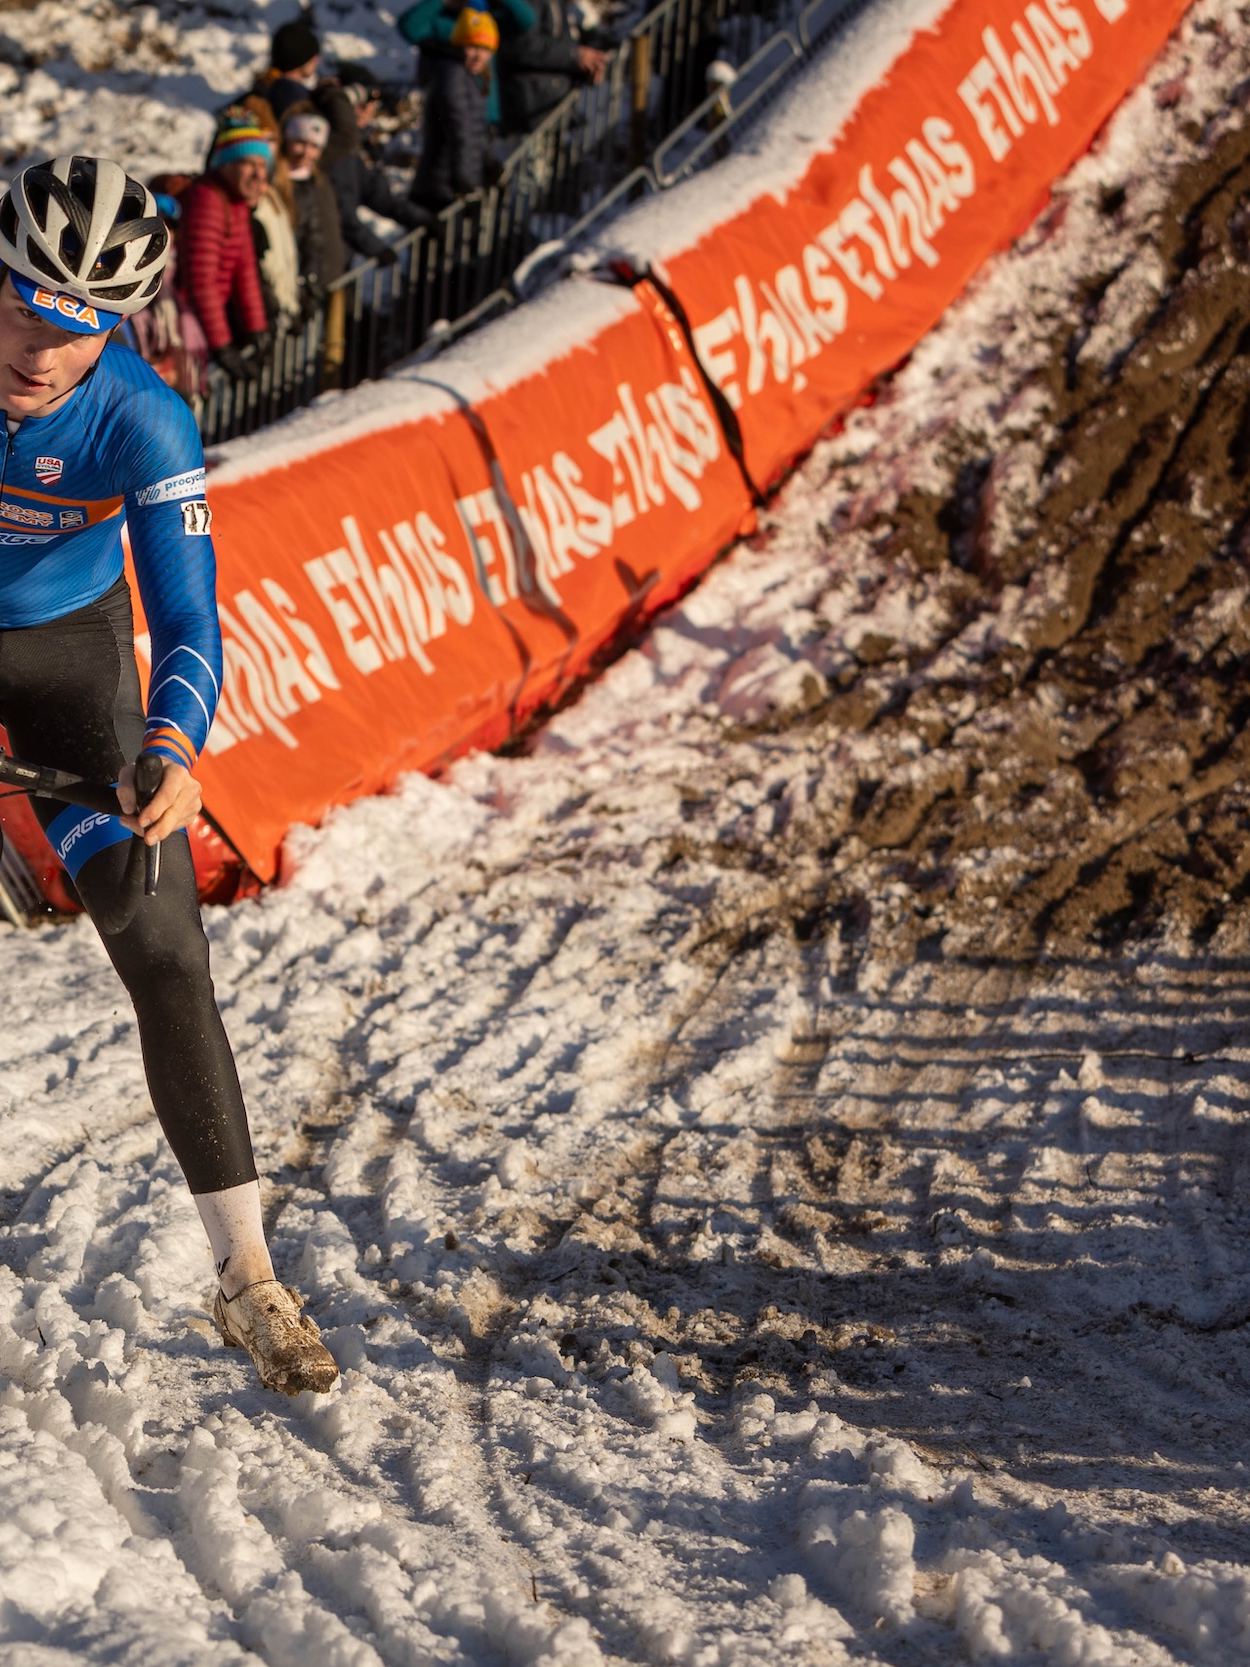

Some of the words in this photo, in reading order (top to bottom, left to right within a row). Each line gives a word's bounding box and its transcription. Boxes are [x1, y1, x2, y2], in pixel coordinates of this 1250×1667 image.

[32, 287, 100, 330] ECA
[38, 458, 61, 467] USA
[185, 503, 209, 533] 17
[57, 812, 110, 860] VERGE
